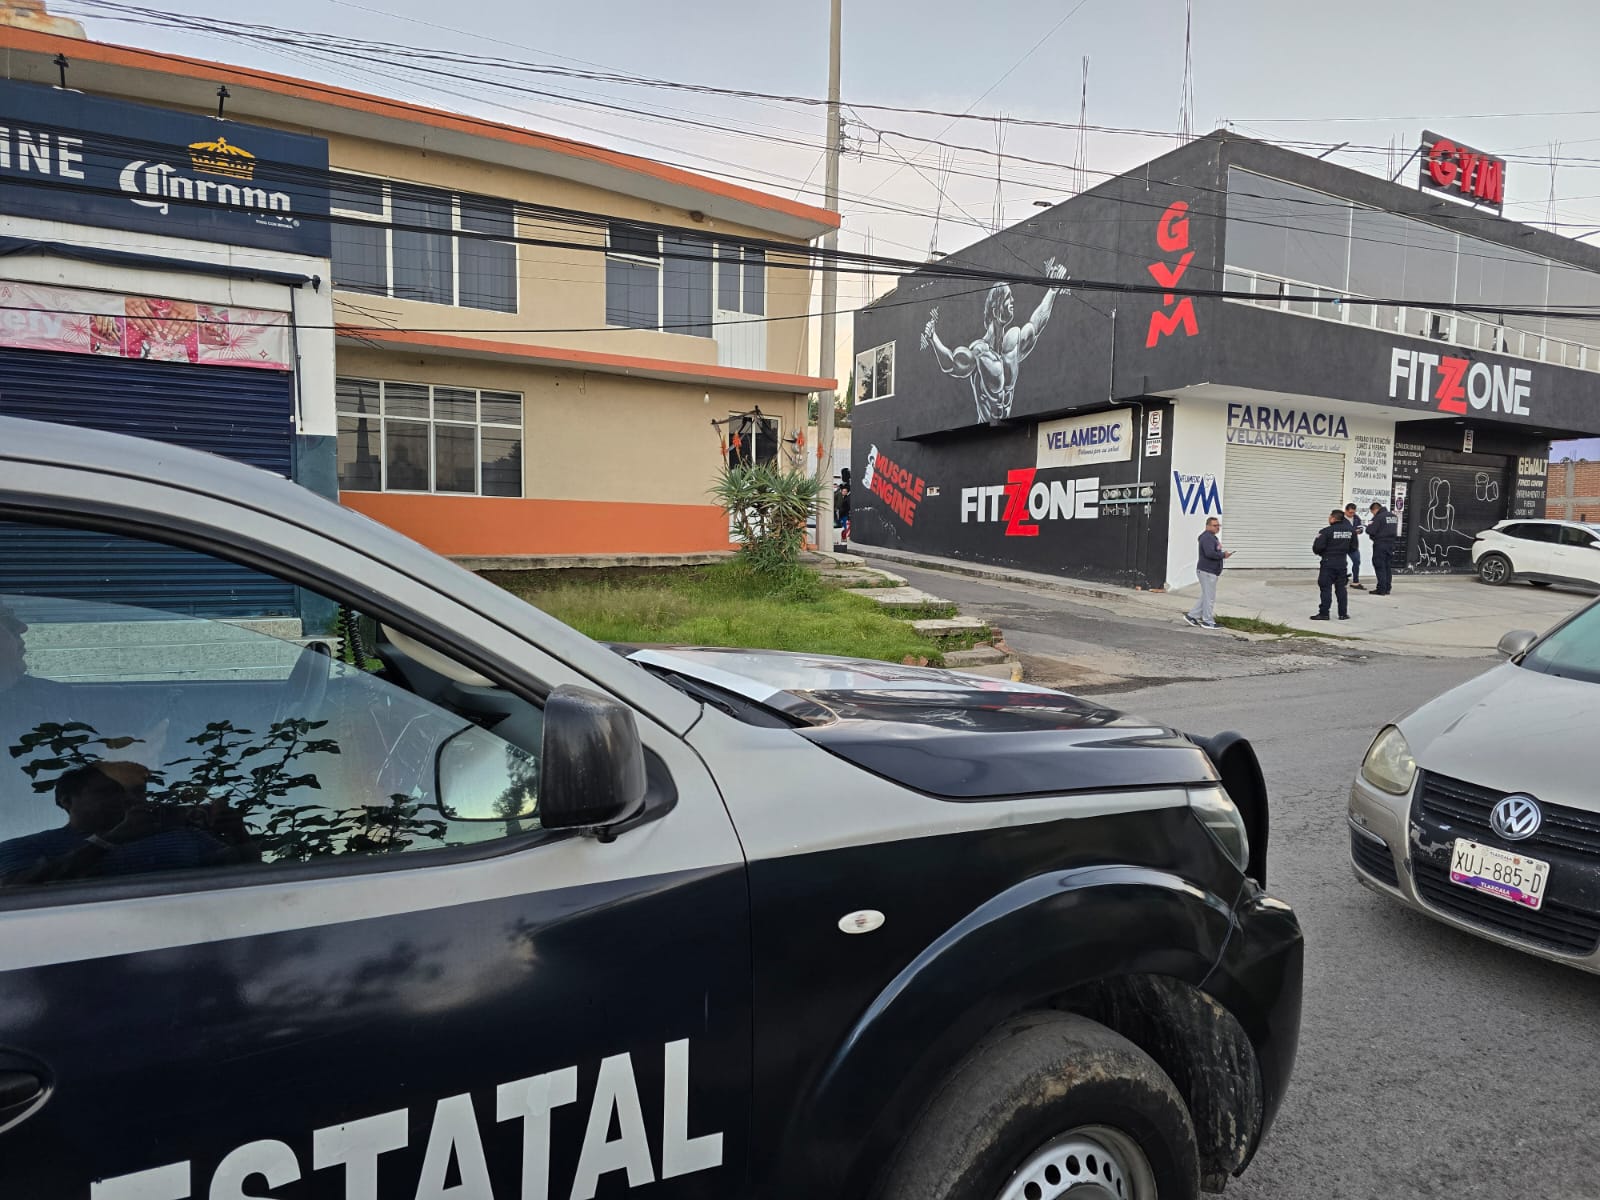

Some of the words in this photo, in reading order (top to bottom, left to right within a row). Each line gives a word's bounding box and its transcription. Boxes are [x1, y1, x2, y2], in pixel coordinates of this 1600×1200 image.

[1428, 138, 1503, 204] GYM
[1145, 201, 1200, 348] GYM
[1389, 347, 1532, 416] FITZONE
[1047, 424, 1121, 450] VELAMEDIC
[1227, 403, 1349, 438] FARMACIA
[1227, 428, 1305, 449] VELAMEDIC
[870, 473, 917, 527] ENGINE
[876, 452, 925, 502] MUSCLE
[1173, 470, 1222, 516] VM
[961, 467, 1100, 536] FITZONE
[1455, 850, 1542, 893] XUJ-885-D
[1480, 881, 1510, 895] TLAXCALA
